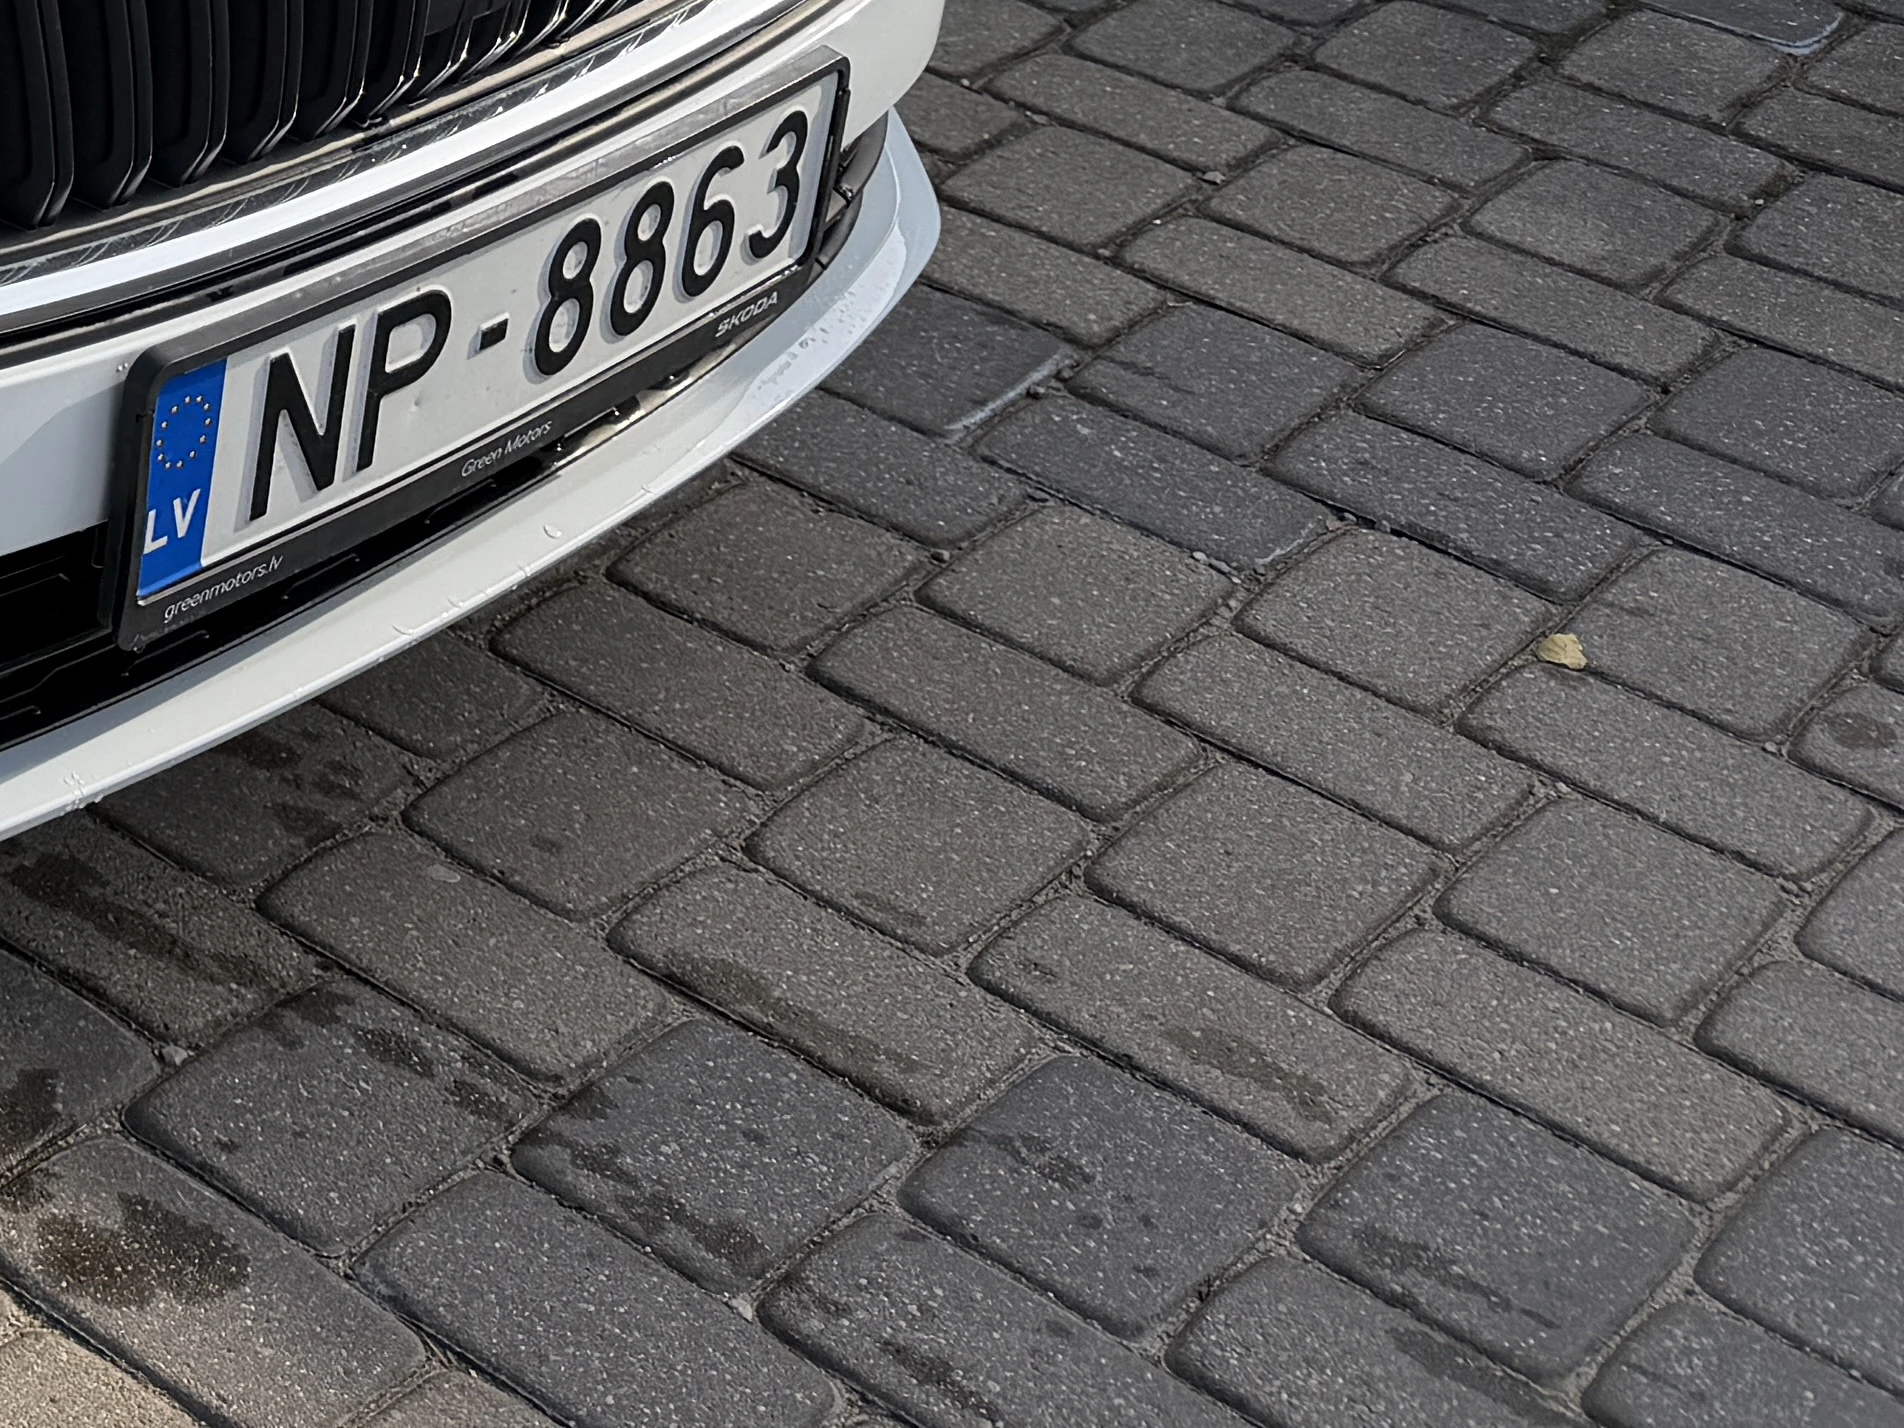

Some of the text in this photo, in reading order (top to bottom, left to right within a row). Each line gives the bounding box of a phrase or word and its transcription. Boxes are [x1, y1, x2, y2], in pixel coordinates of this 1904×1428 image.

[247, 108, 809, 522] NP-8863
[460, 420, 553, 477] Green Motors
[142, 488, 202, 555] LV
[163, 554, 284, 624] greenmotors.lv
